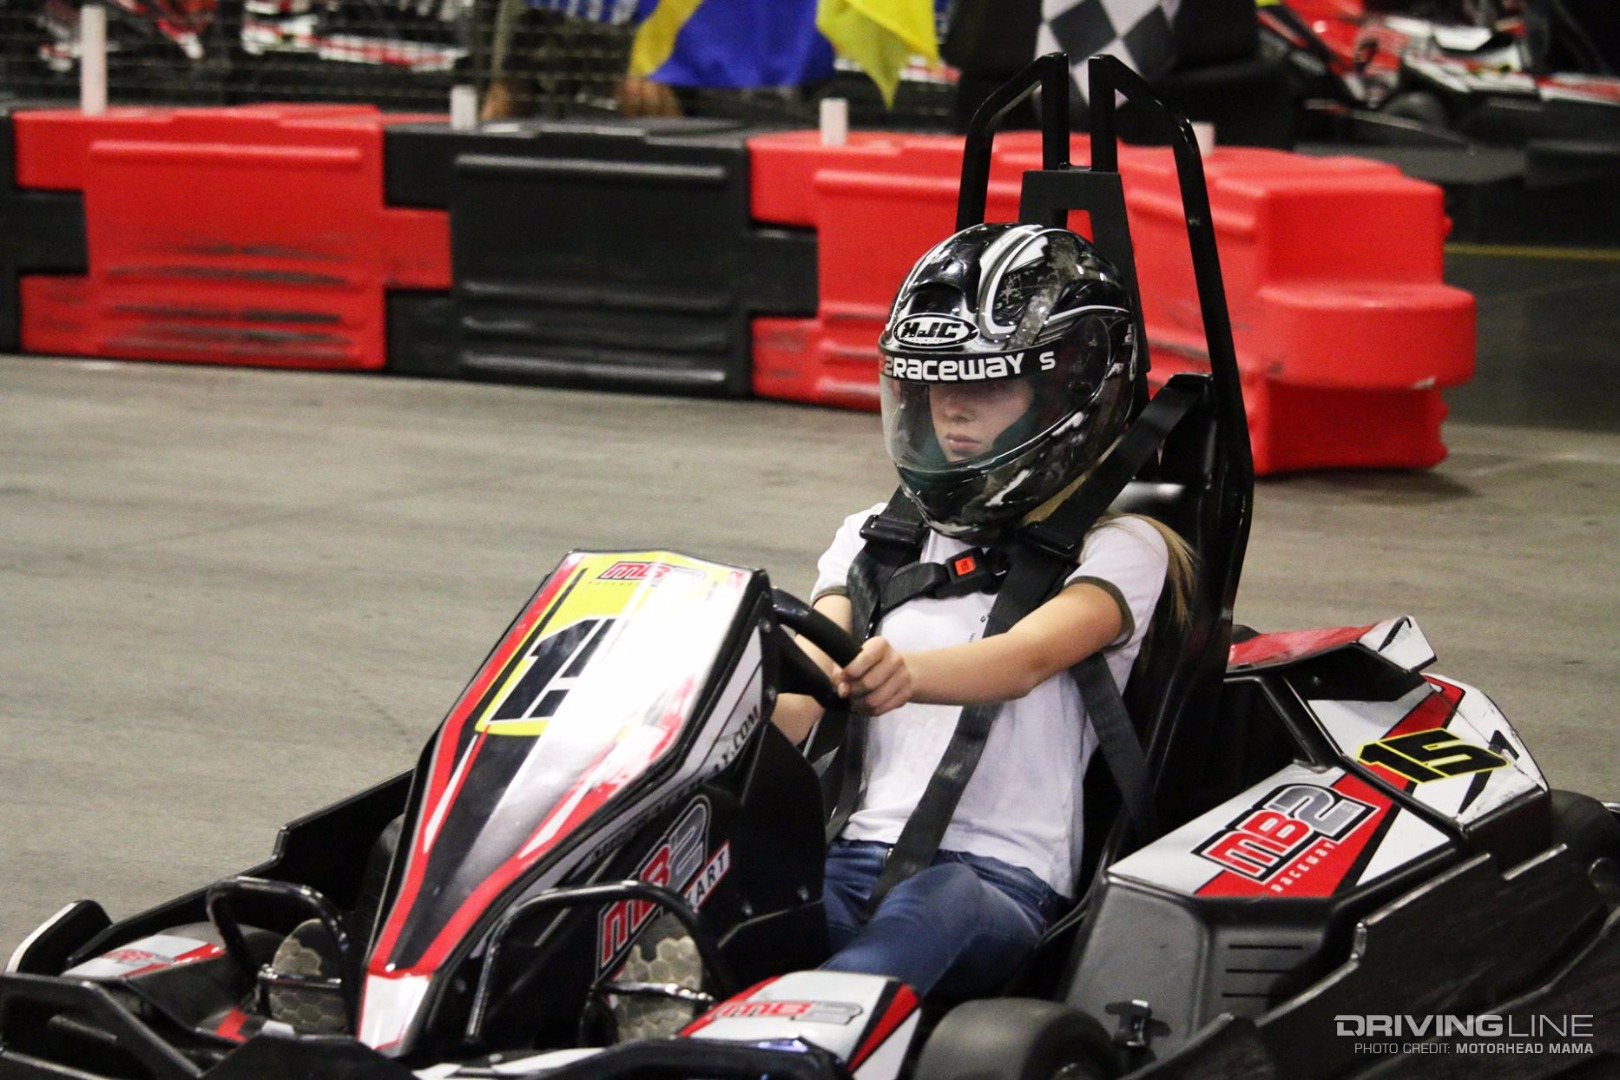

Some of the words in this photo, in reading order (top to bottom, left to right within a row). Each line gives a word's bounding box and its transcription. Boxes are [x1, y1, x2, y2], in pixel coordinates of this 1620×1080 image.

[901, 321, 961, 339] HJC
[1039, 351, 1056, 371] S
[1357, 727, 1510, 784] 15
[1200, 785, 1368, 878] MB2
